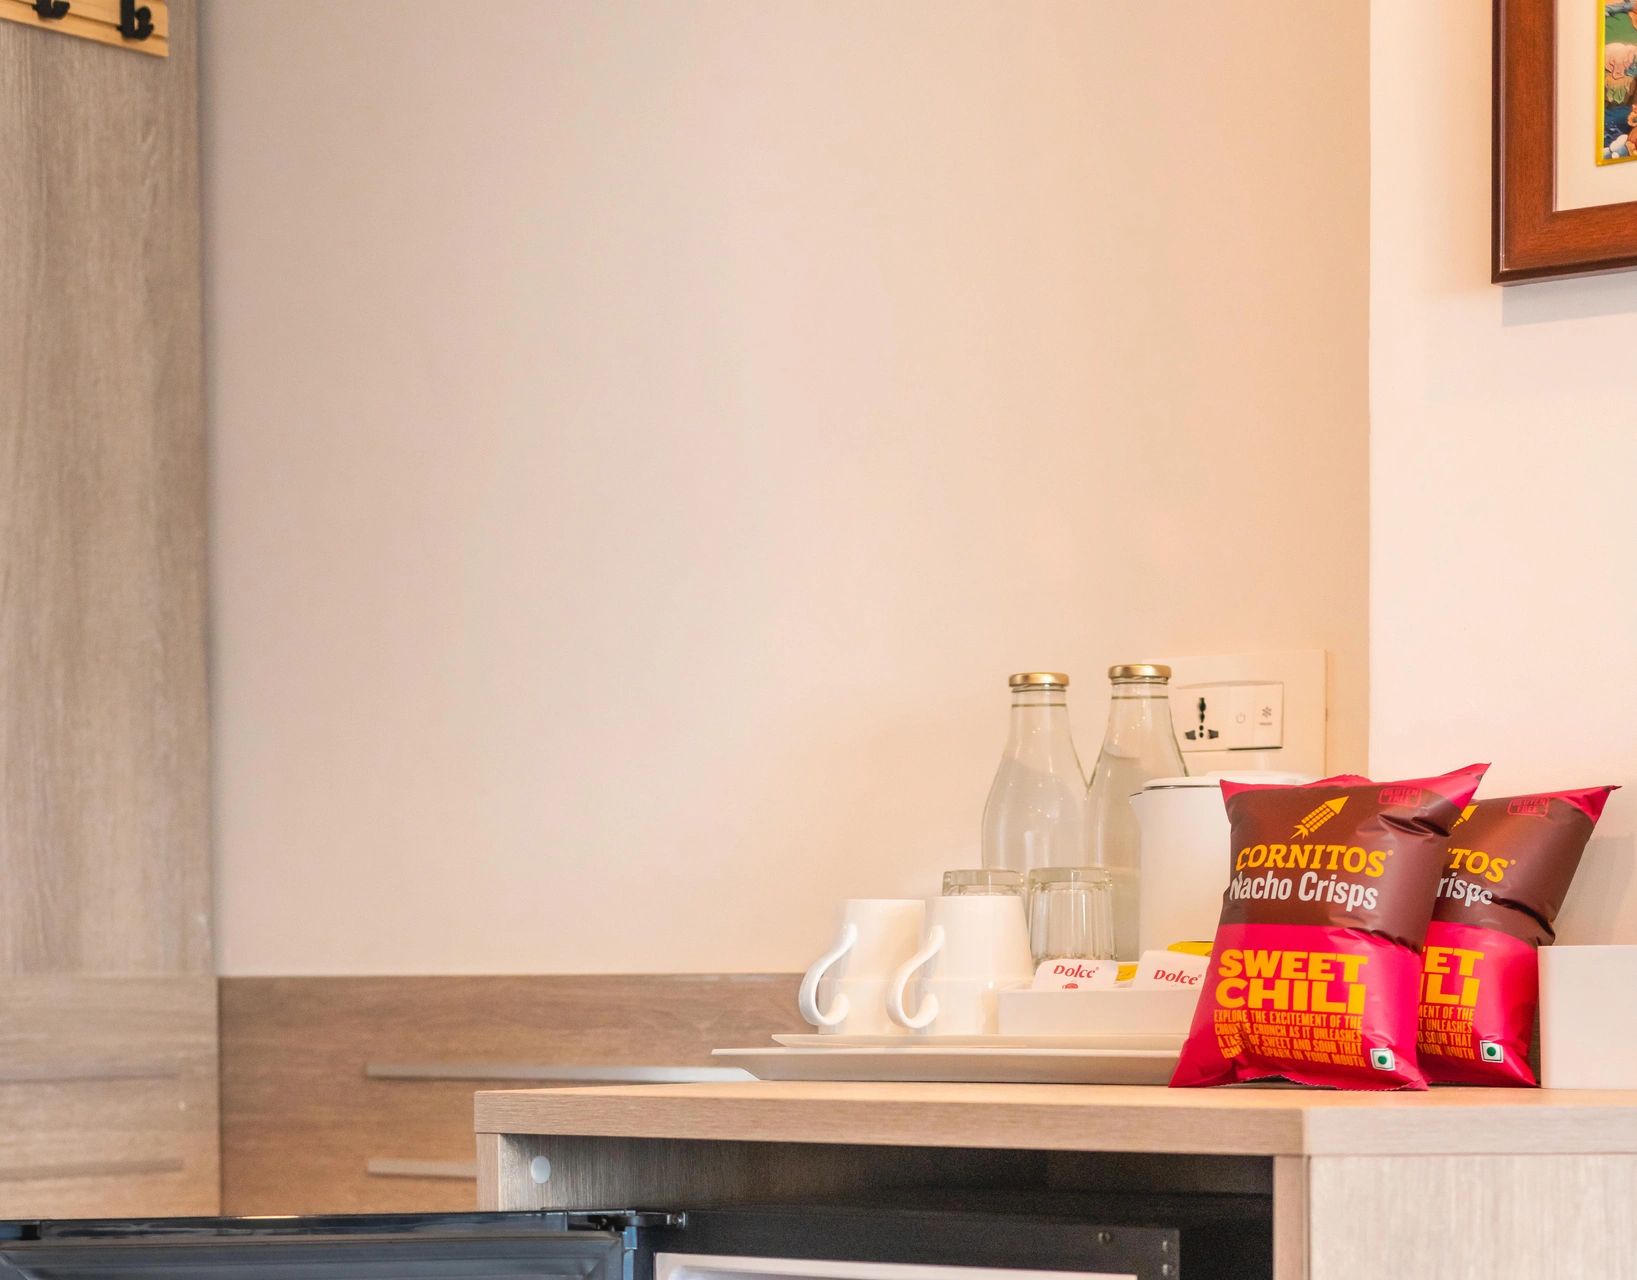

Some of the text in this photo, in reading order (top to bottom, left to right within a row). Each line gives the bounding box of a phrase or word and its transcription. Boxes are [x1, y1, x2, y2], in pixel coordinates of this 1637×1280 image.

[1235, 844, 1387, 878] CORNITOS
[1447, 847, 1509, 883] TOS
[1229, 870, 1379, 913] Nacho Crisps
[1218, 949, 1369, 983] SWEET
[1423, 946, 1485, 976] ET
[1053, 964, 1096, 979] Dolce
[1153, 969, 1199, 985] Dolce
[1215, 977, 1367, 1015] CHILI
[1420, 973, 1480, 1007] LI
[1214, 1009, 1363, 1030] EXPLORE THE EXCITEMENT OF THE
[1419, 1005, 1475, 1022] ENT OF THE
[1253, 1024, 1287, 1037] CRUNCH
[1289, 1026, 1300, 1038] AS
[1302, 1027, 1311, 1039] IT
[1313, 1027, 1362, 1042] UNLEASHES
[1426, 1019, 1473, 1034] UNLEASHES
[1261, 1036, 1290, 1049] SWEET
[1293, 1038, 1312, 1051] AND
[1313, 1039, 1338, 1053] SOUR
[1340, 1042, 1362, 1056] THAT
[1425, 1031, 1448, 1045] SOUR
[1450, 1033, 1472, 1048] THAT
[1306, 1051, 1331, 1064] YOUR
